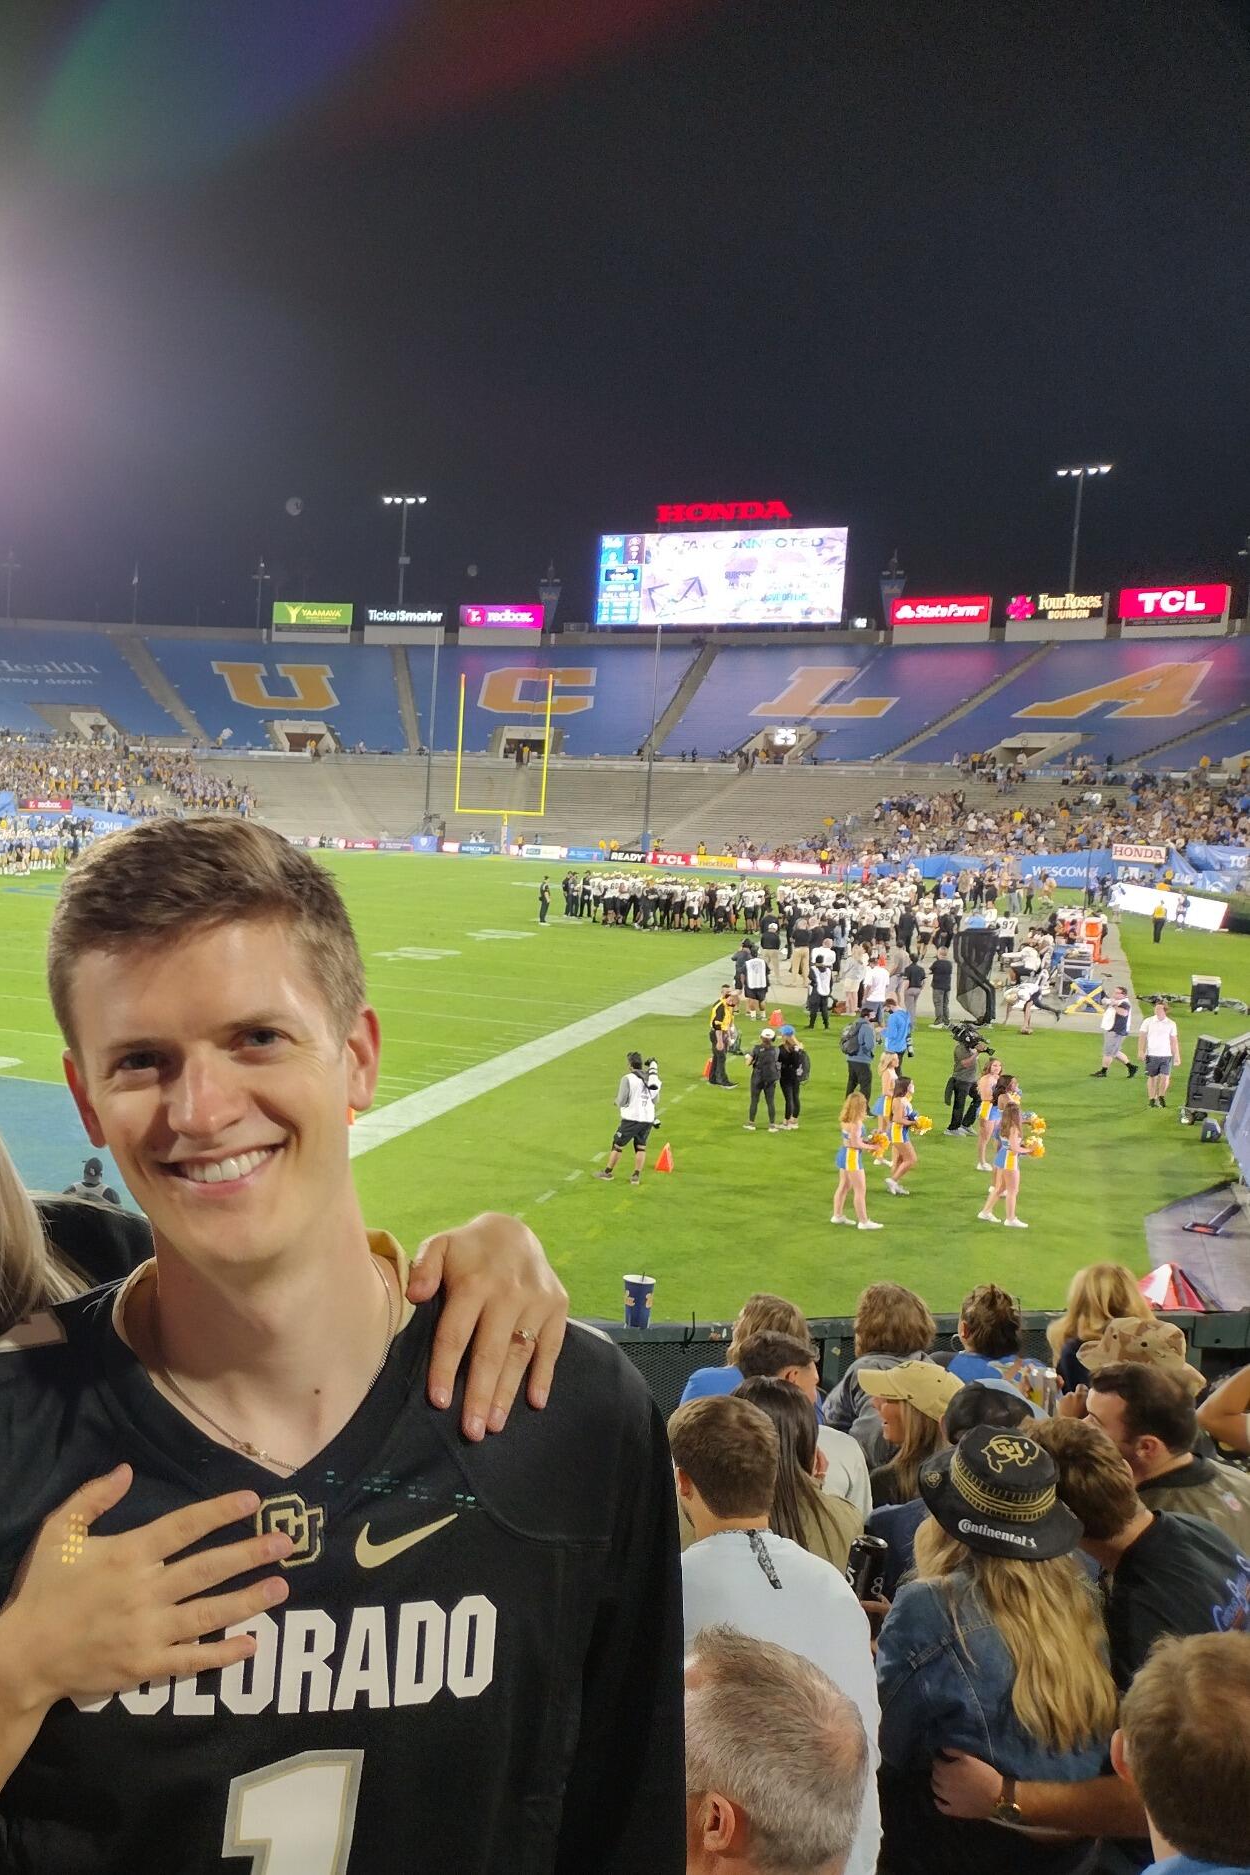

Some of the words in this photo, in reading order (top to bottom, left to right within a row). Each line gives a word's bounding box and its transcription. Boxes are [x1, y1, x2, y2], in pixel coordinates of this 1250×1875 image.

[656, 501, 792, 522] HONDA
[1138, 590, 1205, 613] TCL
[368, 609, 443, 622] TicketSmarter
[1048, 610, 1090, 619] BOURBON
[610, 852, 644, 862] READY
[1113, 845, 1166, 860] HONDA
[657, 855, 686, 865] TCL
[1230, 855, 1247, 868] TC
[1001, 919, 1015, 930] 97
[957, 1518, 1028, 1547] Continental
[67, 1594, 498, 1716] LORADO
[222, 1749, 364, 1875] 1
